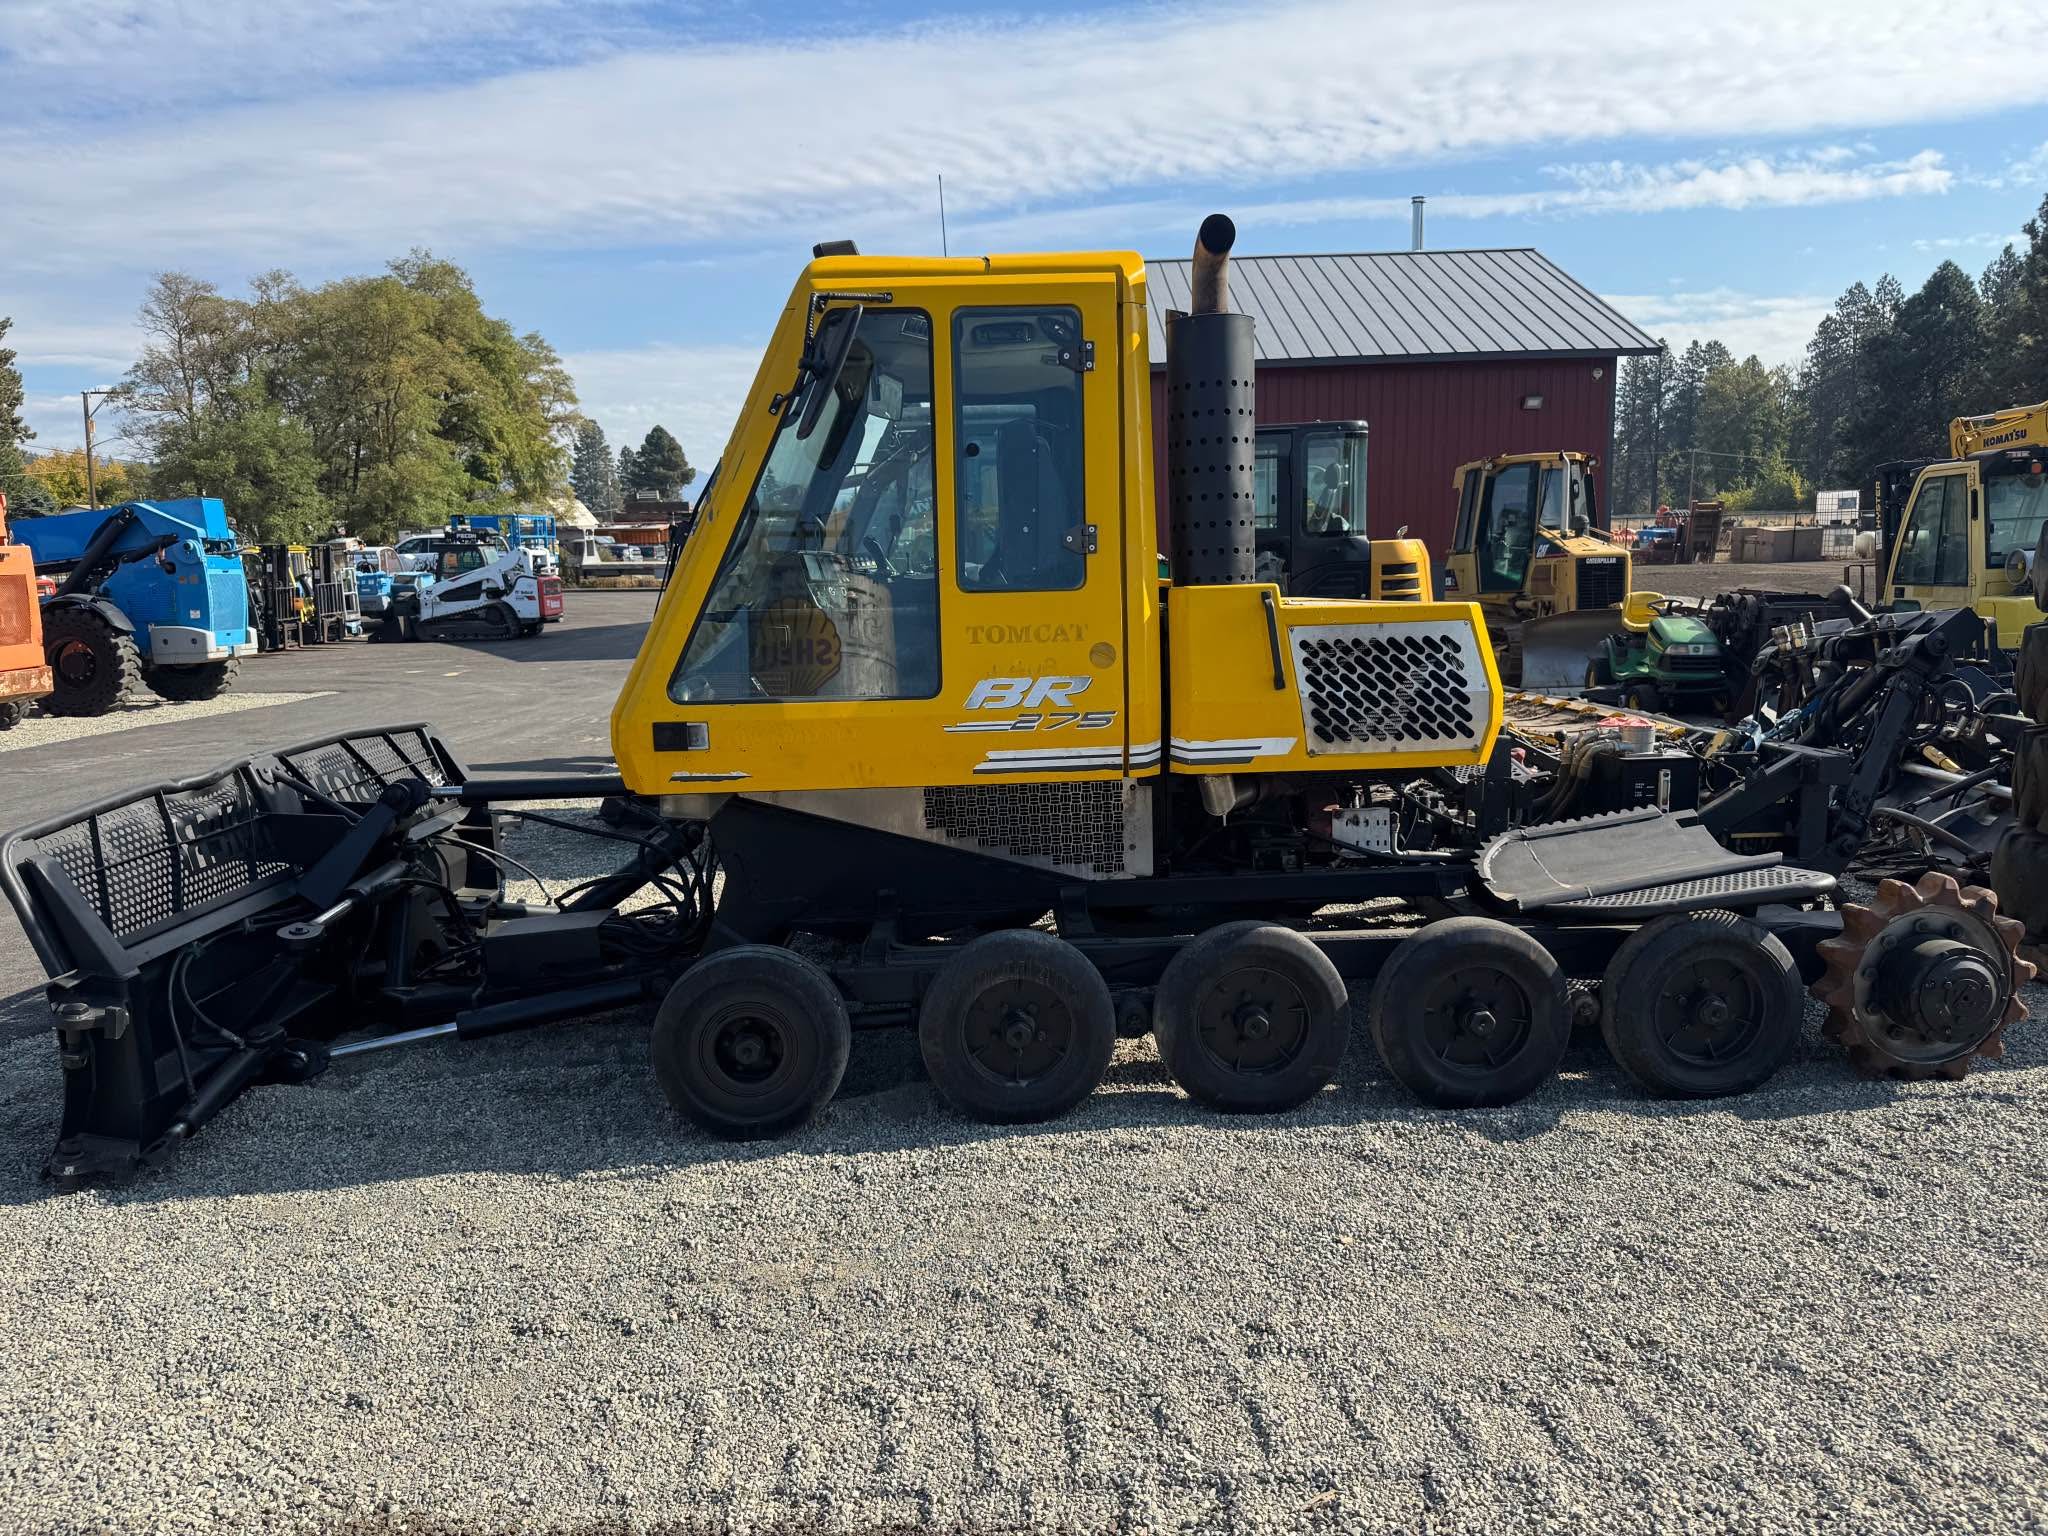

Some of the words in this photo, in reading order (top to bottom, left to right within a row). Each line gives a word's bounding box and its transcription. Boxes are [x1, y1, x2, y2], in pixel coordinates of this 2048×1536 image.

[1983, 429, 2027, 447] KOMATSU
[1536, 544, 1549, 558] CAT
[1585, 557, 1617, 565] CATERPILLAR
[967, 624, 1089, 645] TOMCAT
[963, 675, 1093, 710] BR
[1009, 711, 1118, 732] 275
